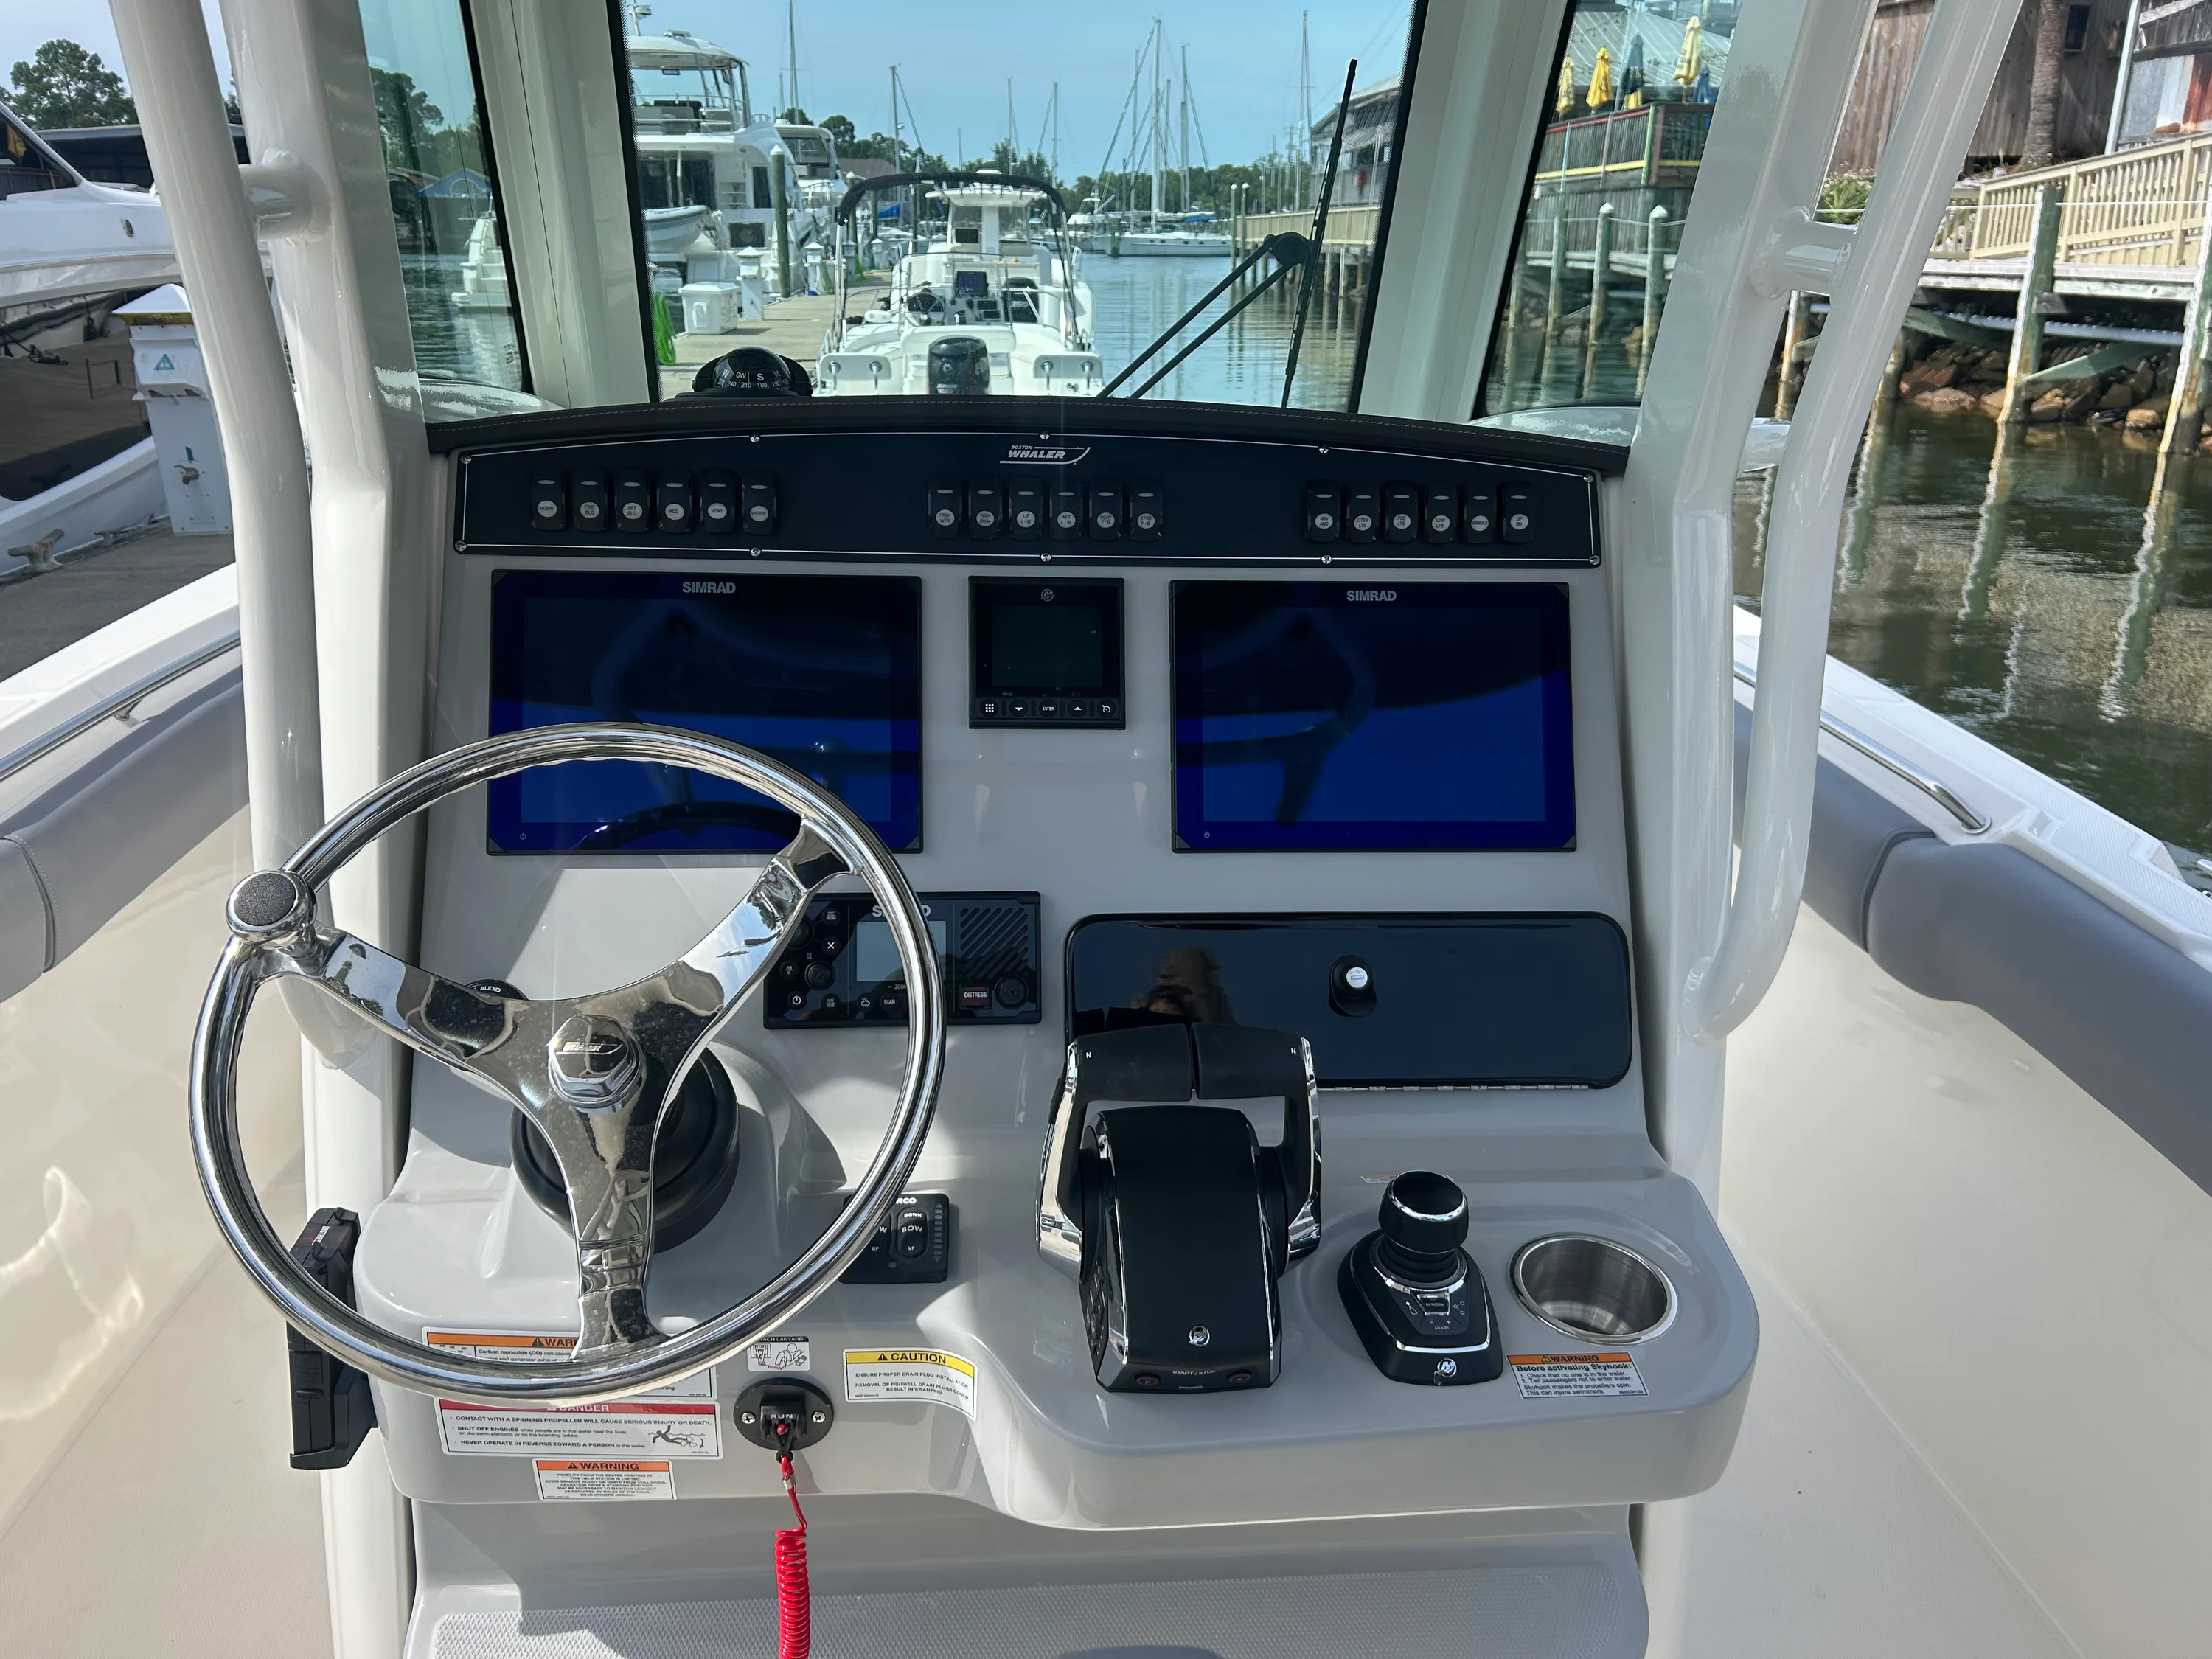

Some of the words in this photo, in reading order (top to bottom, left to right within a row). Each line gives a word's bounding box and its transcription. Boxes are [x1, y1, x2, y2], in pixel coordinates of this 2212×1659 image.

[722, 369, 730, 378] W
[757, 373, 764, 381] S
[1008, 450, 1065, 459] WHALER
[682, 581, 737, 594] SIMRAD
[1346, 590, 1397, 602] SIMRAD
[479, 985, 501, 993] AUDIO
[895, 1197, 917, 1205] NCO
[902, 1225, 922, 1233] BOW
[891, 1352, 946, 1364] CAUTION
[935, 1374, 968, 1389] INSTALLATION
[914, 1387, 943, 1395] SWAMPING
[936, 1384, 953, 1392] PLUGS
[953, 1389, 969, 1399] COULD
[580, 1462, 639, 1470] WARNING
